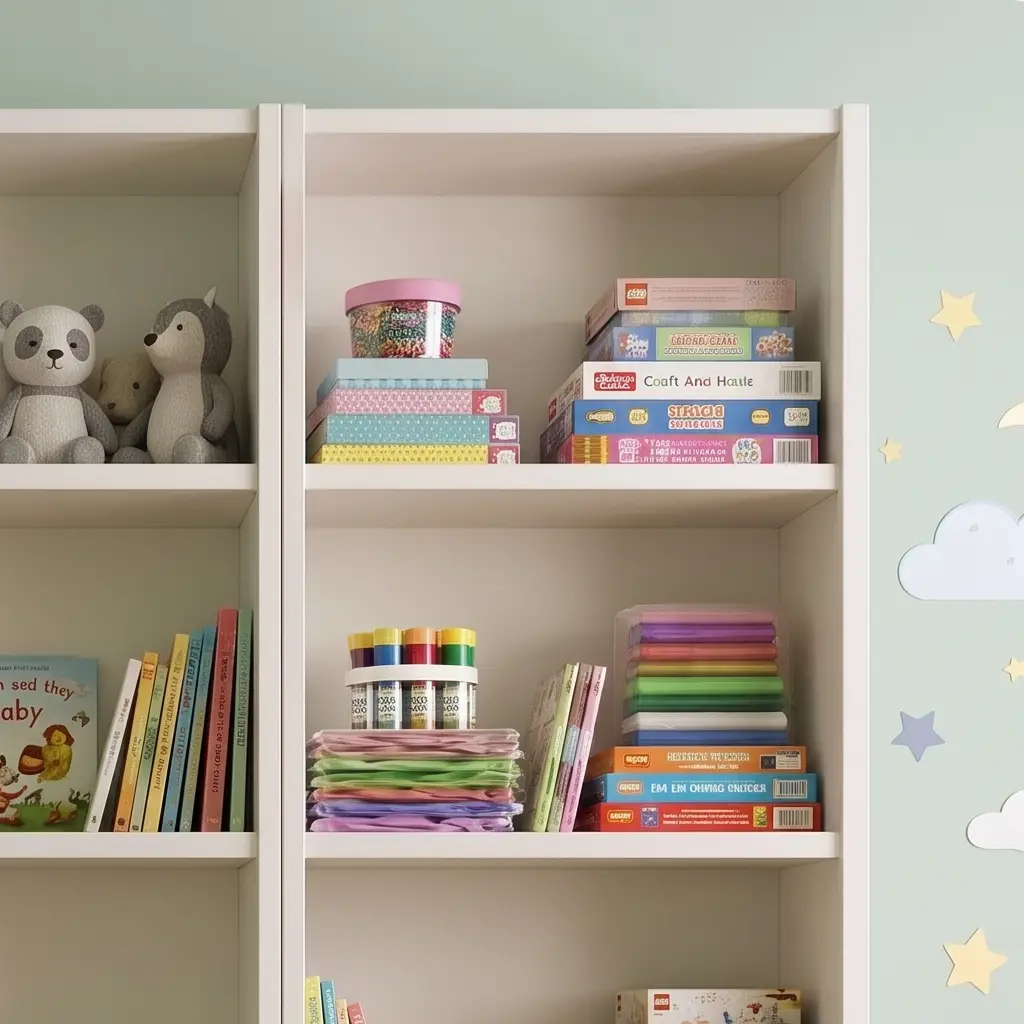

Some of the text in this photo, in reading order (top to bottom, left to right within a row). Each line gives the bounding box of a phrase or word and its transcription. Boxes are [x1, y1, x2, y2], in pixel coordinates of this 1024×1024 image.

[684, 376, 711, 387] And
[11, 677, 38, 691] sed
[44, 680, 75, 701] they
